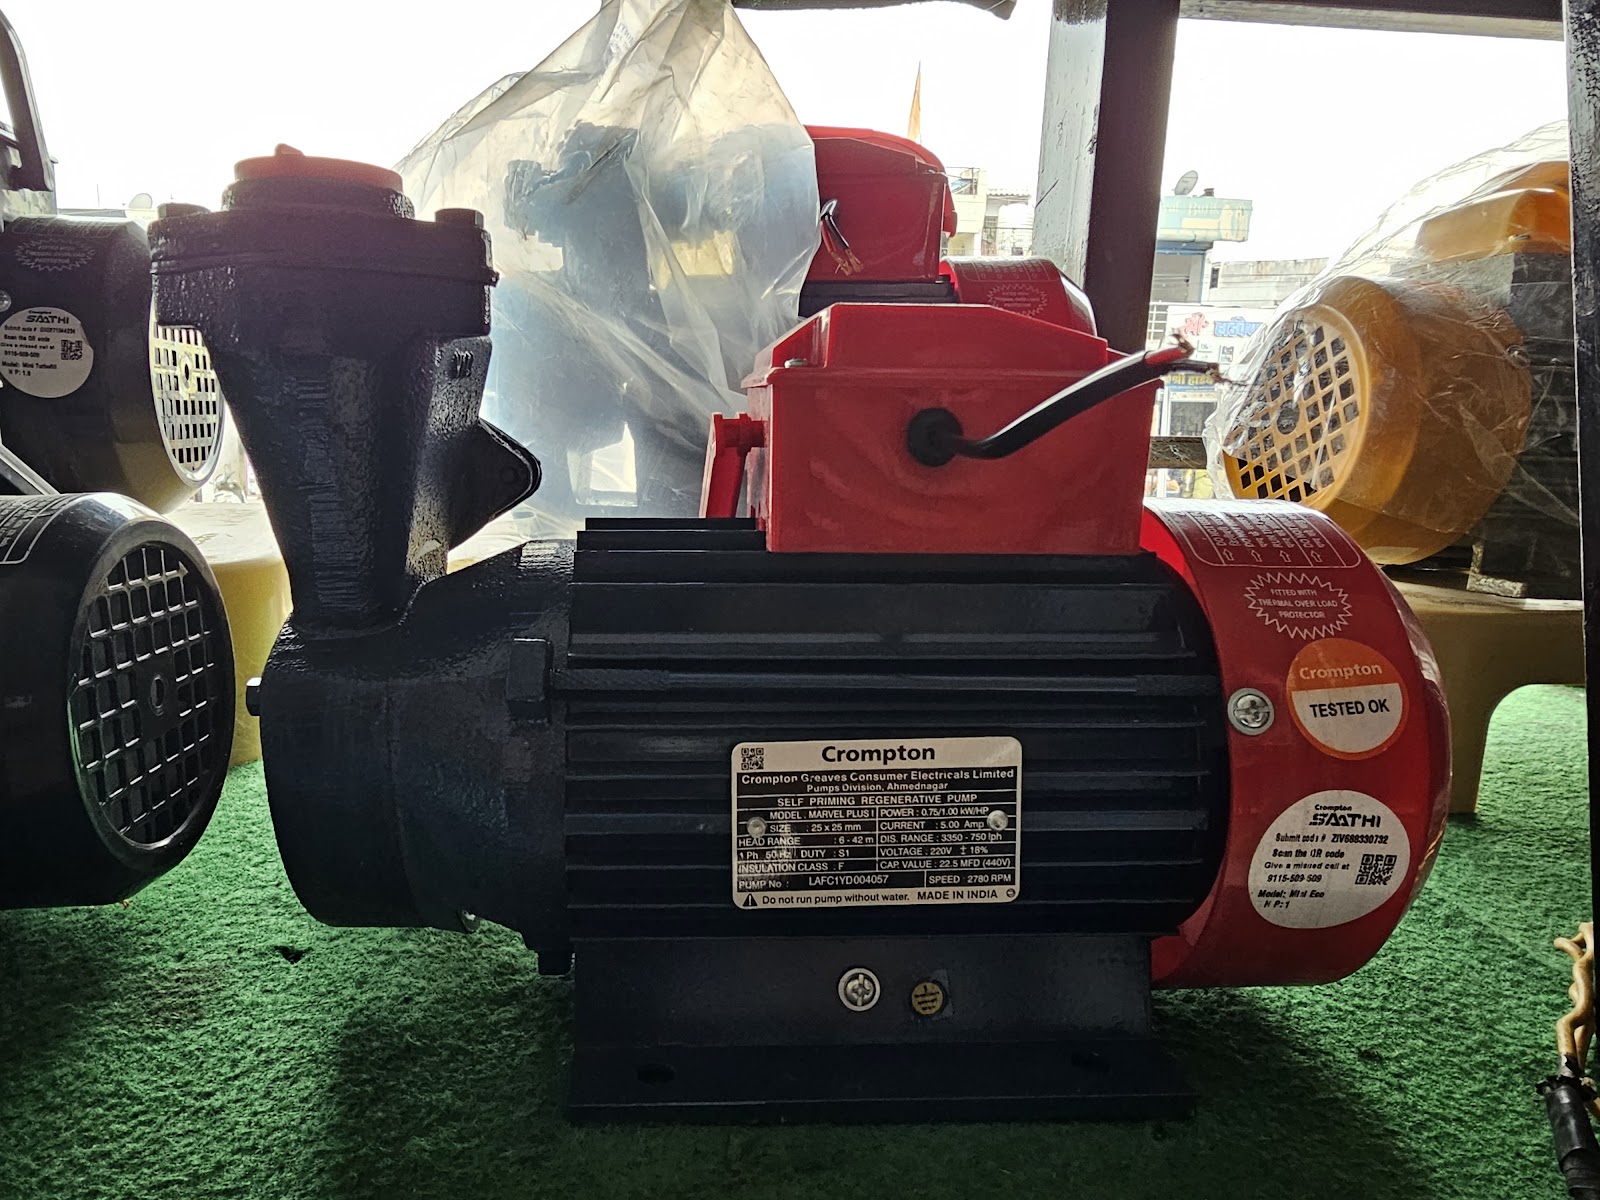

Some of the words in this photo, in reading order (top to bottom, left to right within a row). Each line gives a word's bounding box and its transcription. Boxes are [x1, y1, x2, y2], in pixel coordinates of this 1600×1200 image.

[1270, 588, 1296, 596] FITTED
[1258, 599, 1293, 607] THERMAL
[1295, 600, 1316, 608] OVER
[1318, 600, 1338, 608] LOAD
[1279, 610, 1325, 619] PROTECTOR
[1300, 664, 1382, 680] Crompton
[1310, 700, 1365, 718] TESTED
[1368, 699, 1390, 713] OK
[821, 745, 935, 765] Crompton
[742, 774, 798, 785] Crompton
[801, 773, 847, 783] Greaves
[850, 772, 908, 781] Consumer
[911, 770, 970, 780] Electricals
[972, 769, 1014, 779] Limited
[807, 784, 840, 794] Pumps
[842, 783, 885, 793] Division,
[887, 782, 948, 792] Ahmednagar
[778, 798, 804, 807] SELF
[810, 797, 856, 806] PRIMING
[861, 795, 942, 805] REGENERATIVE
[947, 794, 978, 803] PUMP
[921, 807, 958, 817] 0.75/1.00
[960, 806, 989, 816] kW/HP
[1315, 804, 1352, 812] Crompton
[808, 810, 845, 819] MARVEL
[847, 809, 870, 818] PLUS
[880, 821, 926, 830] CURRENT
[940, 820, 960, 829] 5.00
[1309, 813, 1381, 828] SAATHI
[770, 825, 791, 833] SIZE
[811, 824, 822, 832] 25
[844, 824, 862, 832] mm
[739, 838, 765, 847] HEAD
[768, 837, 801, 846] RANGE
[852, 836, 863, 844] 42
[880, 834, 898, 843] DIS.
[901, 834, 934, 843] RANGE
[941, 834, 963, 842] 3350
[970, 833, 987, 841] 750
[1276, 833, 1300, 842] Submit
[746, 852, 759, 860] Ph
[766, 851, 777, 859] 50
[801, 849, 826, 858] DUTY
[839, 849, 849, 857] S1
[880, 848, 923, 856] VOLTAGE
[930, 847, 953, 855] 220V
[970, 846, 989, 854] 18%
[1272, 849, 1292, 858] Scan
[1295, 849, 1307, 858] the
[1325, 850, 1345, 858] code
[739, 863, 796, 874] INSULATION
[798, 862, 828, 871] CLASS
[839, 862, 845, 870] F
[880, 861, 900, 869] CAP.
[902, 860, 932, 868] VALUE
[939, 860, 958, 868] 22.5
[960, 858, 980, 867] MFD
[982, 858, 1011, 868] (440V)
[1293, 862, 1322, 870] missed
[739, 881, 766, 890] PUMP
[809, 875, 889, 886] LAFC1YD004057
[929, 876, 960, 884] SPEED
[968, 874, 989, 883] 2780
[991, 874, 1011, 882] RPM
[762, 896, 776, 905] Do
[778, 896, 794, 904] not
[796, 896, 812, 904] run
[814, 896, 842, 905] pump
[845, 894, 879, 902] without
[882, 894, 910, 902] water.
[918, 890, 949, 900] MADE
[953, 890, 964, 899] IN
[968, 890, 998, 899] INDIA
[1258, 890, 1286, 899] Model:
[1289, 890, 1306, 898] Mini
[1310, 890, 1325, 898] Eco
